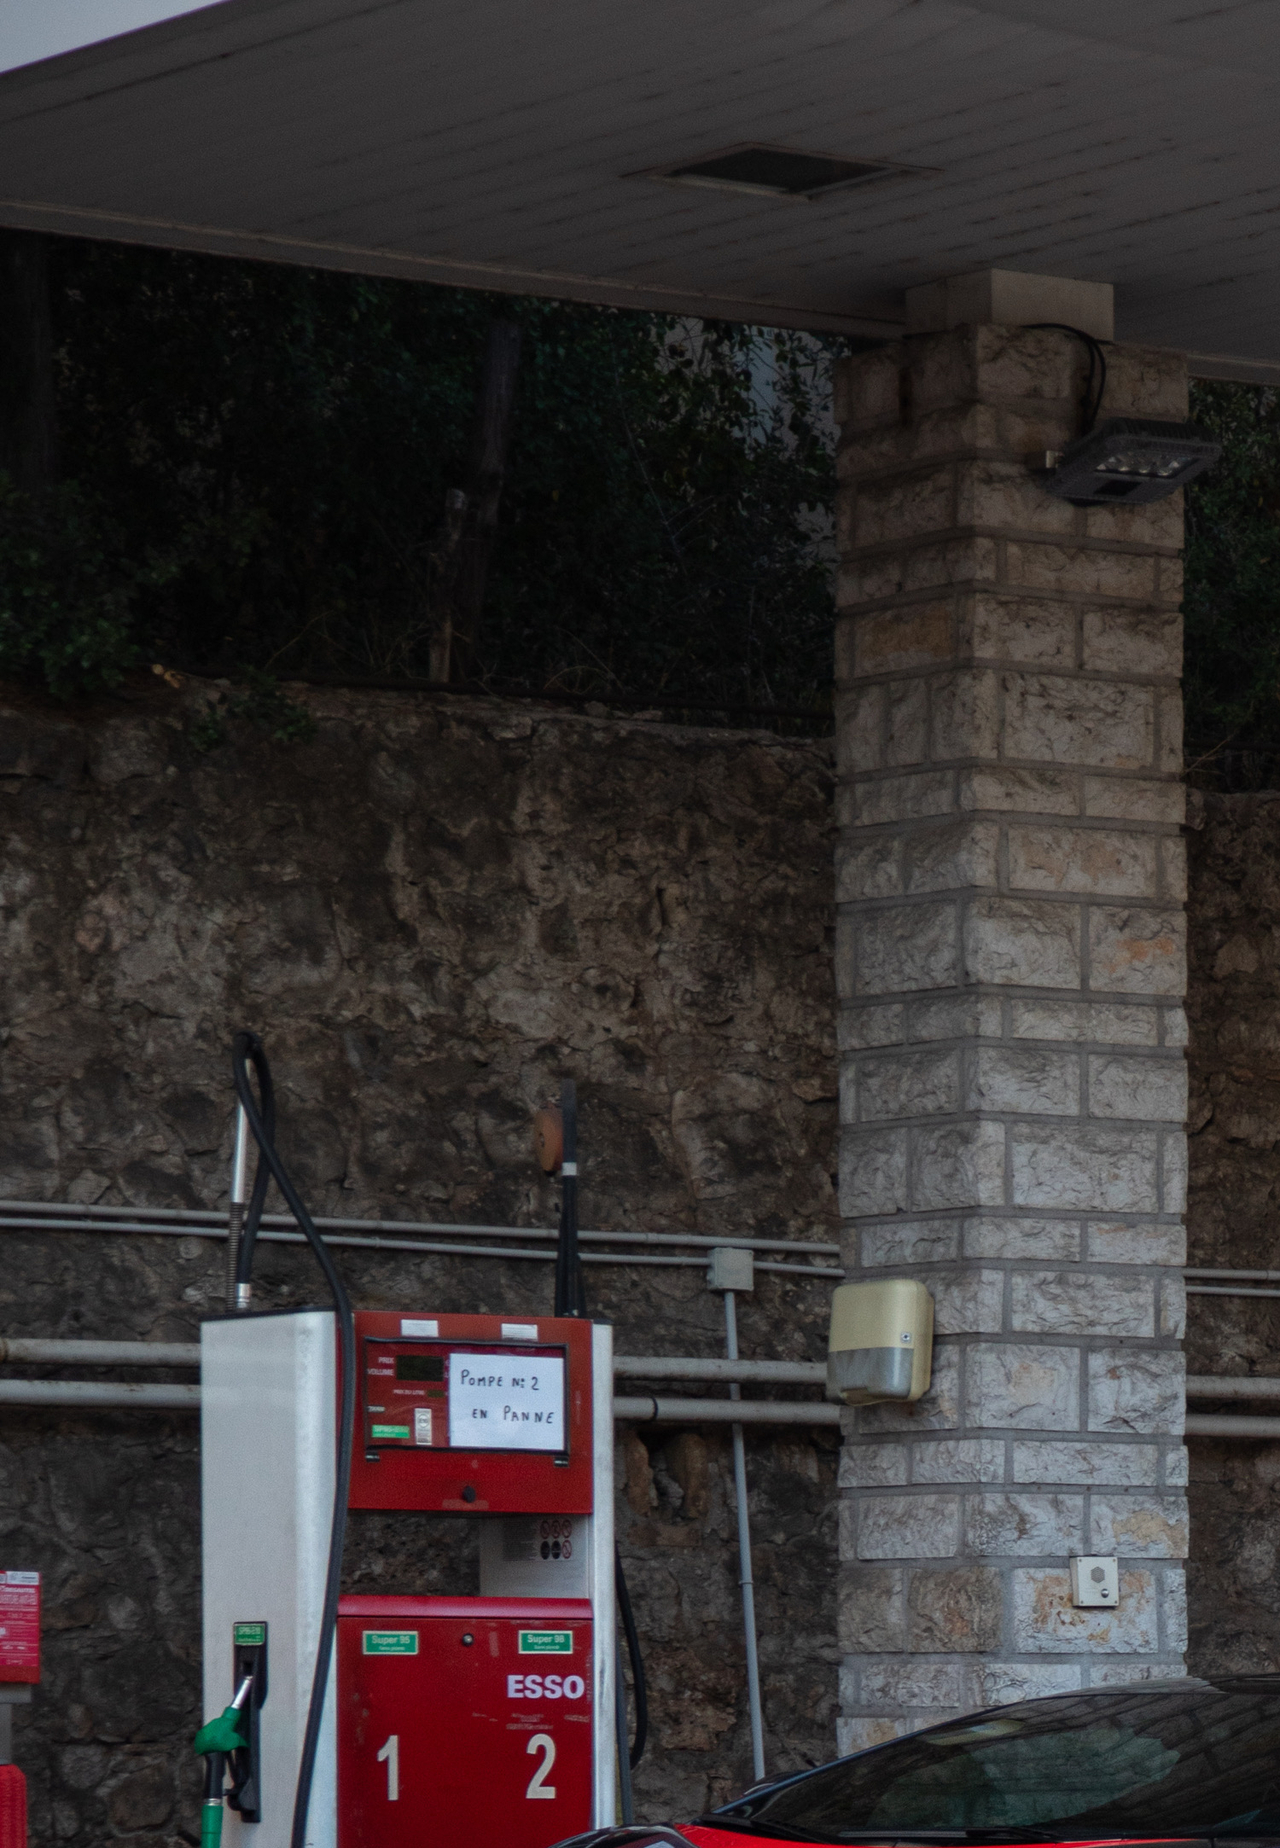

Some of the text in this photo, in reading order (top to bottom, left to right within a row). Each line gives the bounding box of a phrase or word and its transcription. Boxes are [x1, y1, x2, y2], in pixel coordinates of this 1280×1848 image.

[460, 1369, 503, 1387] POMPE
[531, 1376, 540, 1391] 2
[472, 1405, 555, 1424] EN PANNE
[371, 1635, 398, 1645] Super
[527, 1634, 553, 1644] Super
[507, 1674, 585, 1699] ESSO
[377, 1735, 399, 1801] 1
[525, 1733, 556, 1800] 2
